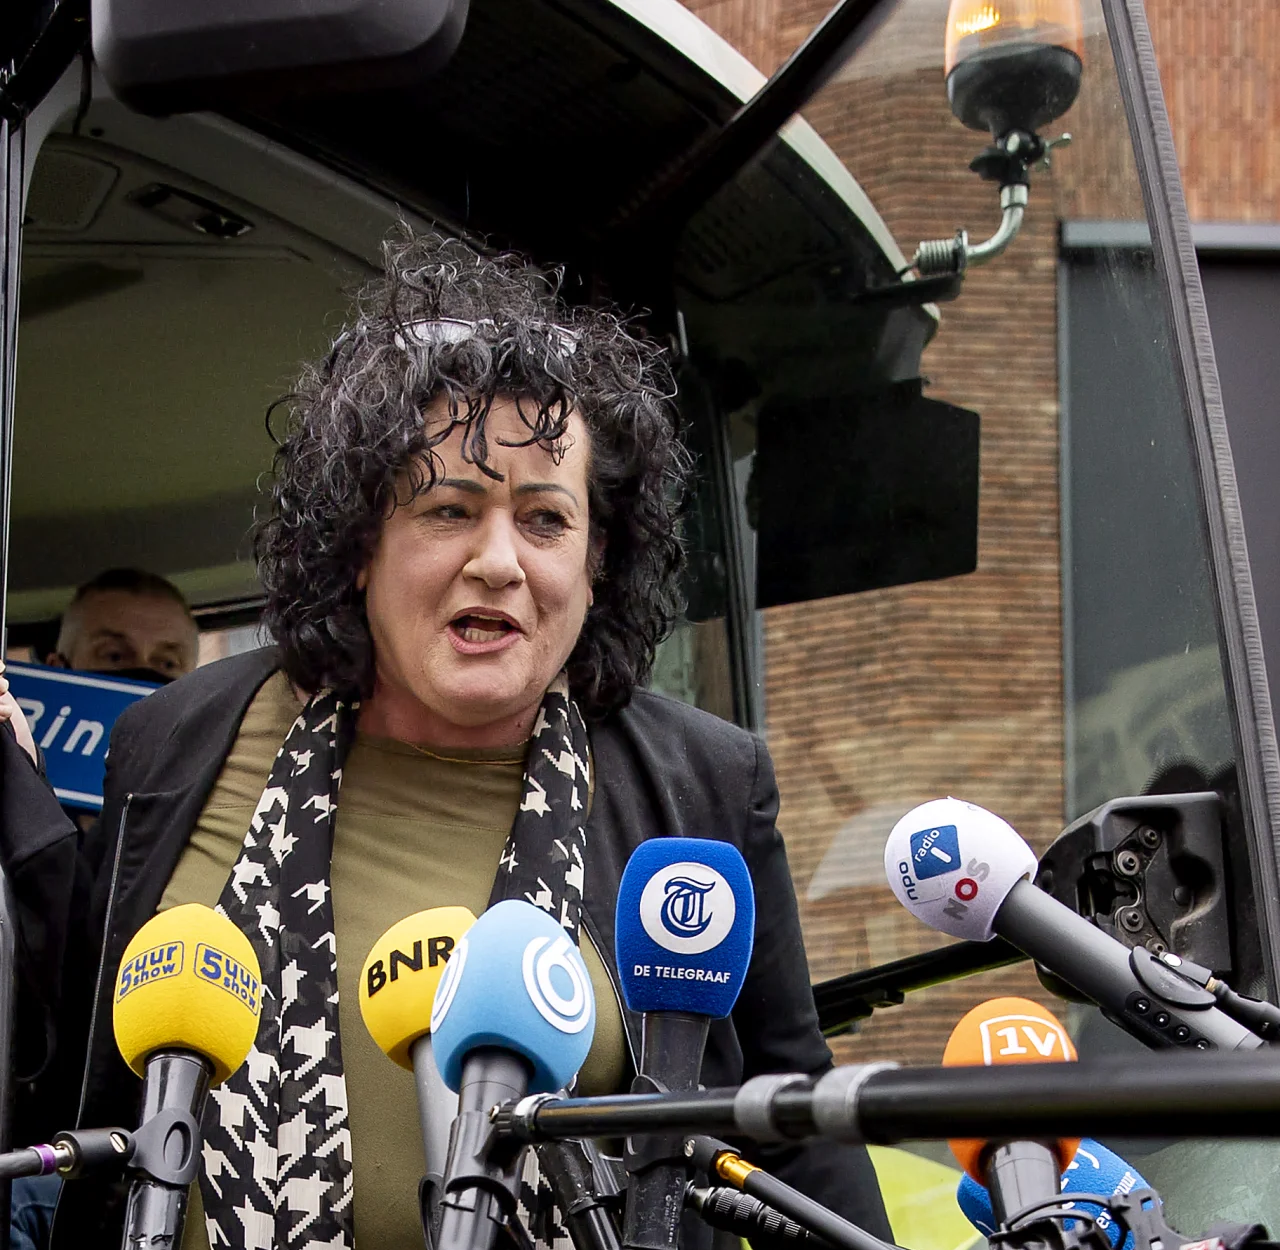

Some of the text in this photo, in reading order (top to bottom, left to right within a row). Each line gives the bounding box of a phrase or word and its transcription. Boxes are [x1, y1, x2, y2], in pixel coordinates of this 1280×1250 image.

[16, 697, 111, 759] Bin
[914, 829, 940, 862] radio
[899, 861, 919, 901] npo
[943, 858, 991, 921] NOS
[133, 963, 176, 986] show
[367, 935, 455, 998] BNR
[634, 965, 731, 984] DE TELEGRAAF
[996, 1026, 1057, 1057] 1V
